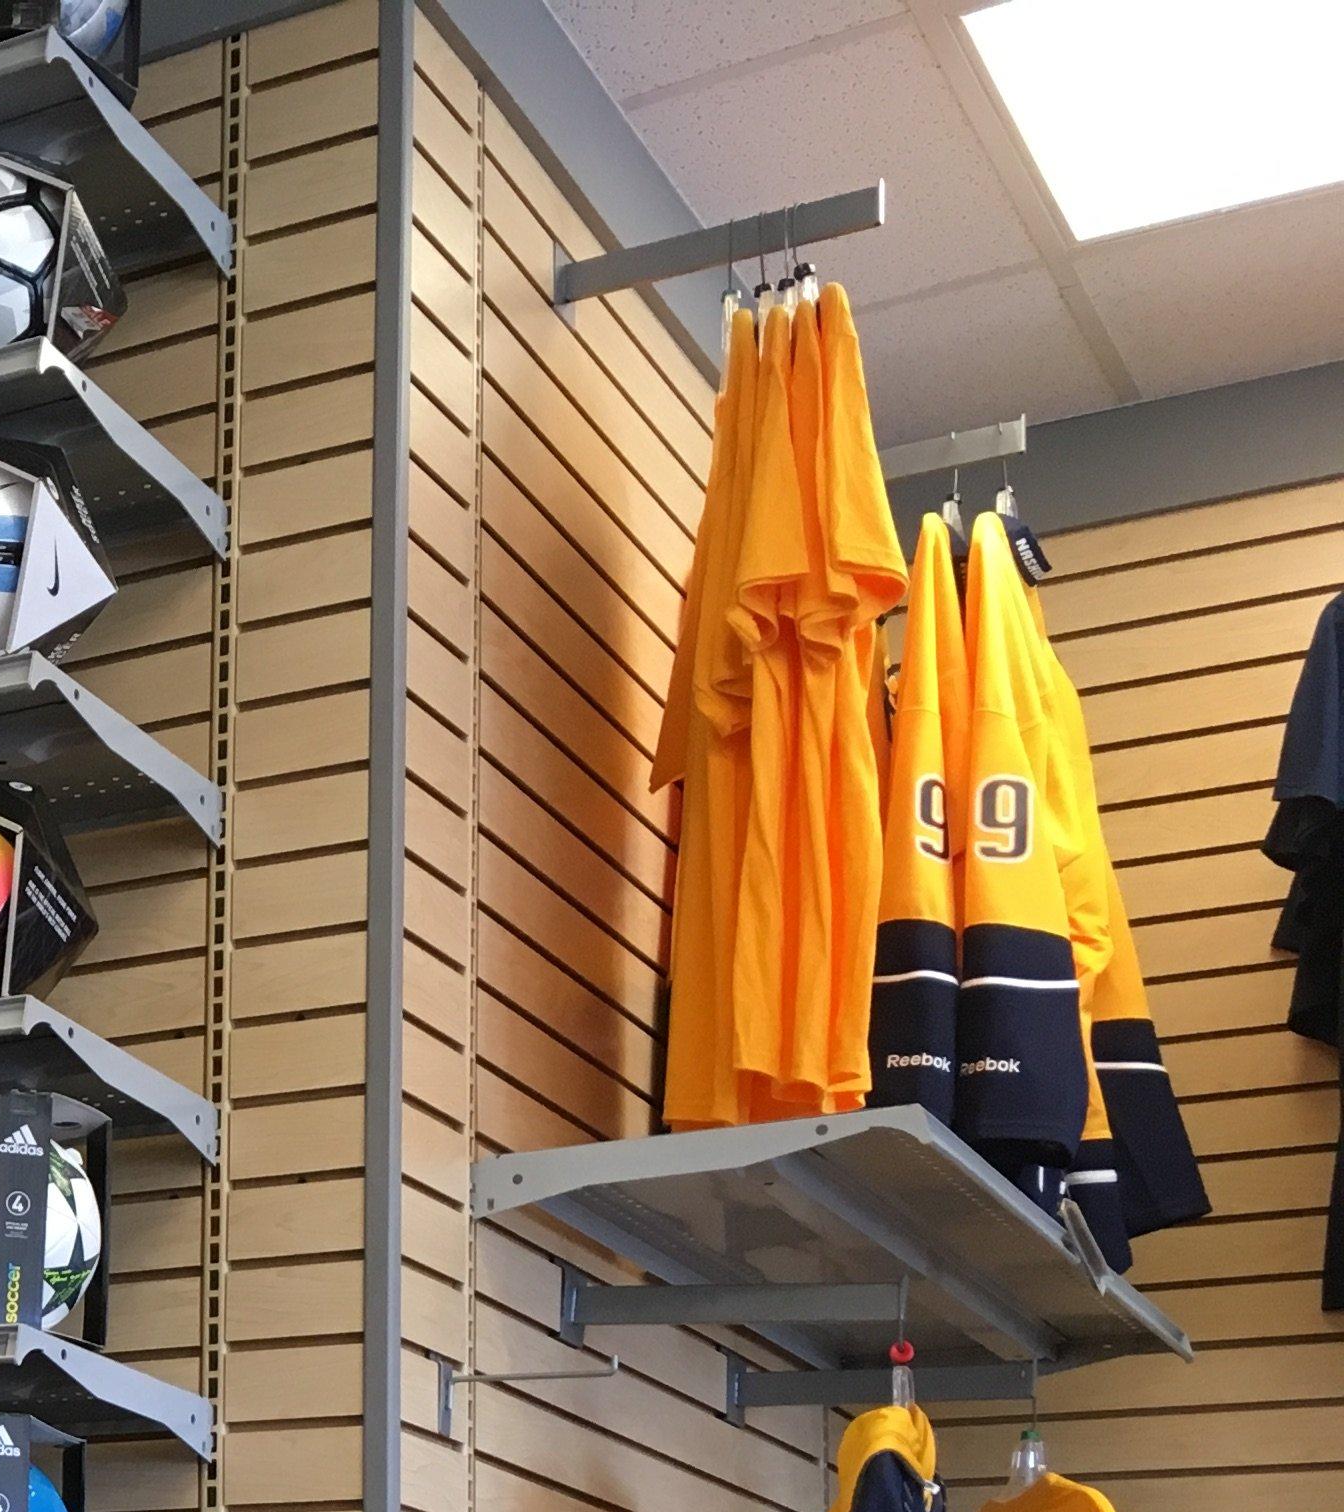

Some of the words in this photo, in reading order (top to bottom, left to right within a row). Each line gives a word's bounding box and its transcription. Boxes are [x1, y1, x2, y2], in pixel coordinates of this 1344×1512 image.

[974, 773, 1035, 864] 9
[887, 1053, 951, 1073] Reebok
[960, 1054, 1020, 1075] Reebok
